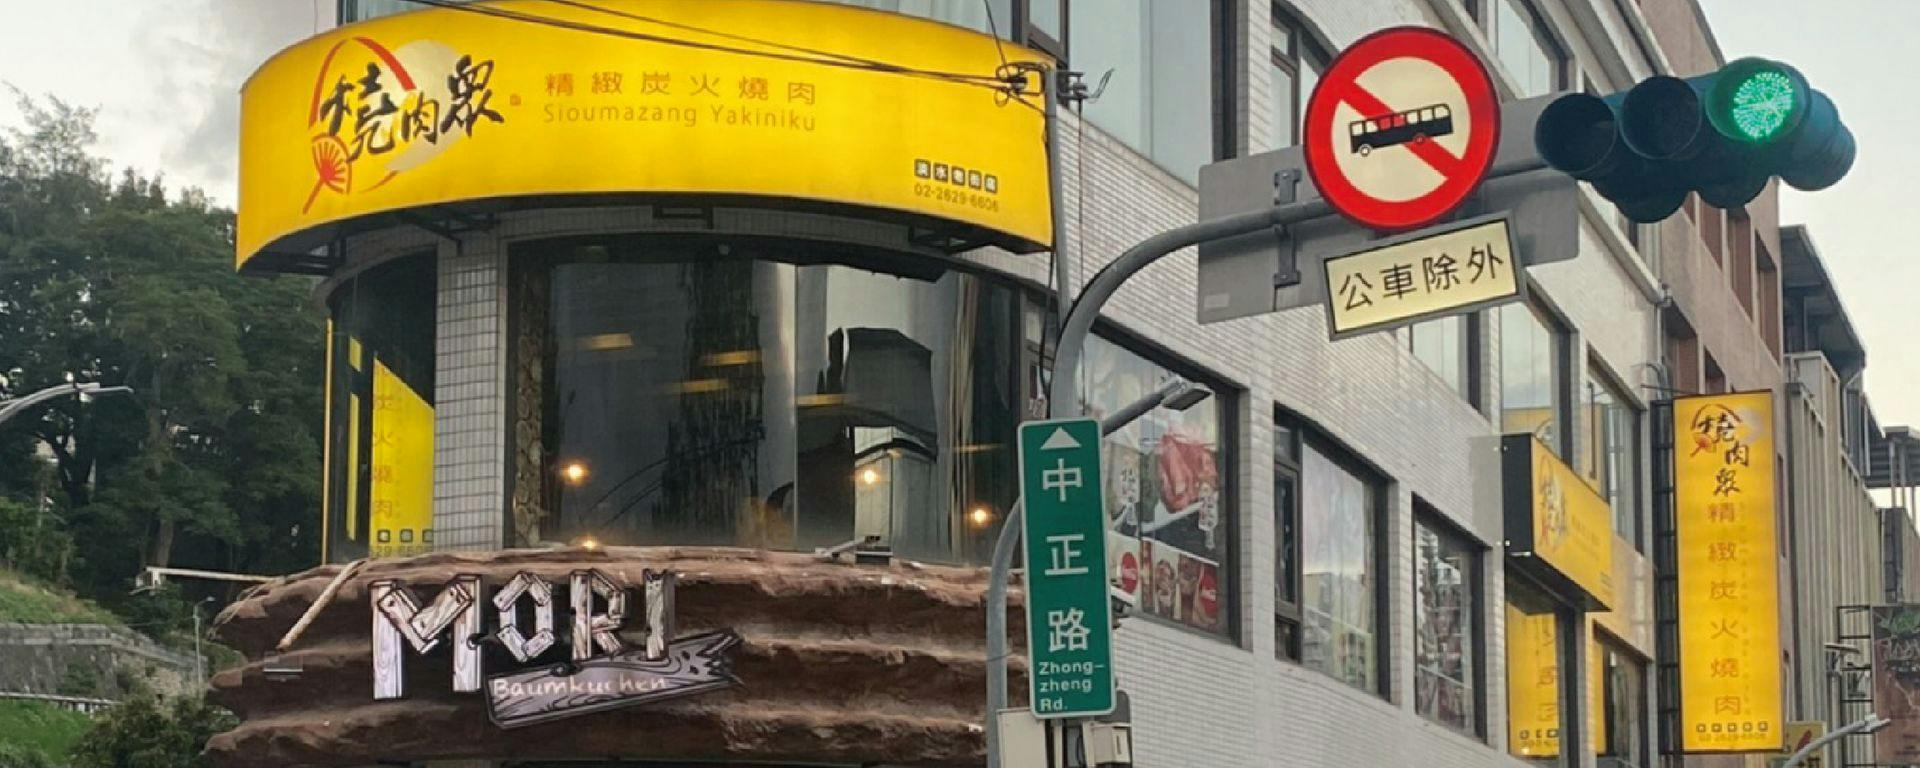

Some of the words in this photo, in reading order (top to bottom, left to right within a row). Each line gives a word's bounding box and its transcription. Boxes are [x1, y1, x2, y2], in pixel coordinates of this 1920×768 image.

[545, 71, 816, 106] 精緻炭火燒肉
[543, 103, 697, 128] Sioumazang
[711, 103, 816, 132] Yakiniku
[1339, 242, 1504, 312] 公車除外
[1041, 457, 1091, 653] 中正路
[1707, 502, 1742, 717] 精緻炭火燒肉
[368, 568, 675, 701] MORI
[1038, 661, 1105, 676] Zhong-
[492, 673, 667, 699] Baumkuchen
[1039, 678, 1093, 693] zheng
[1039, 697, 1069, 712] Rd.
